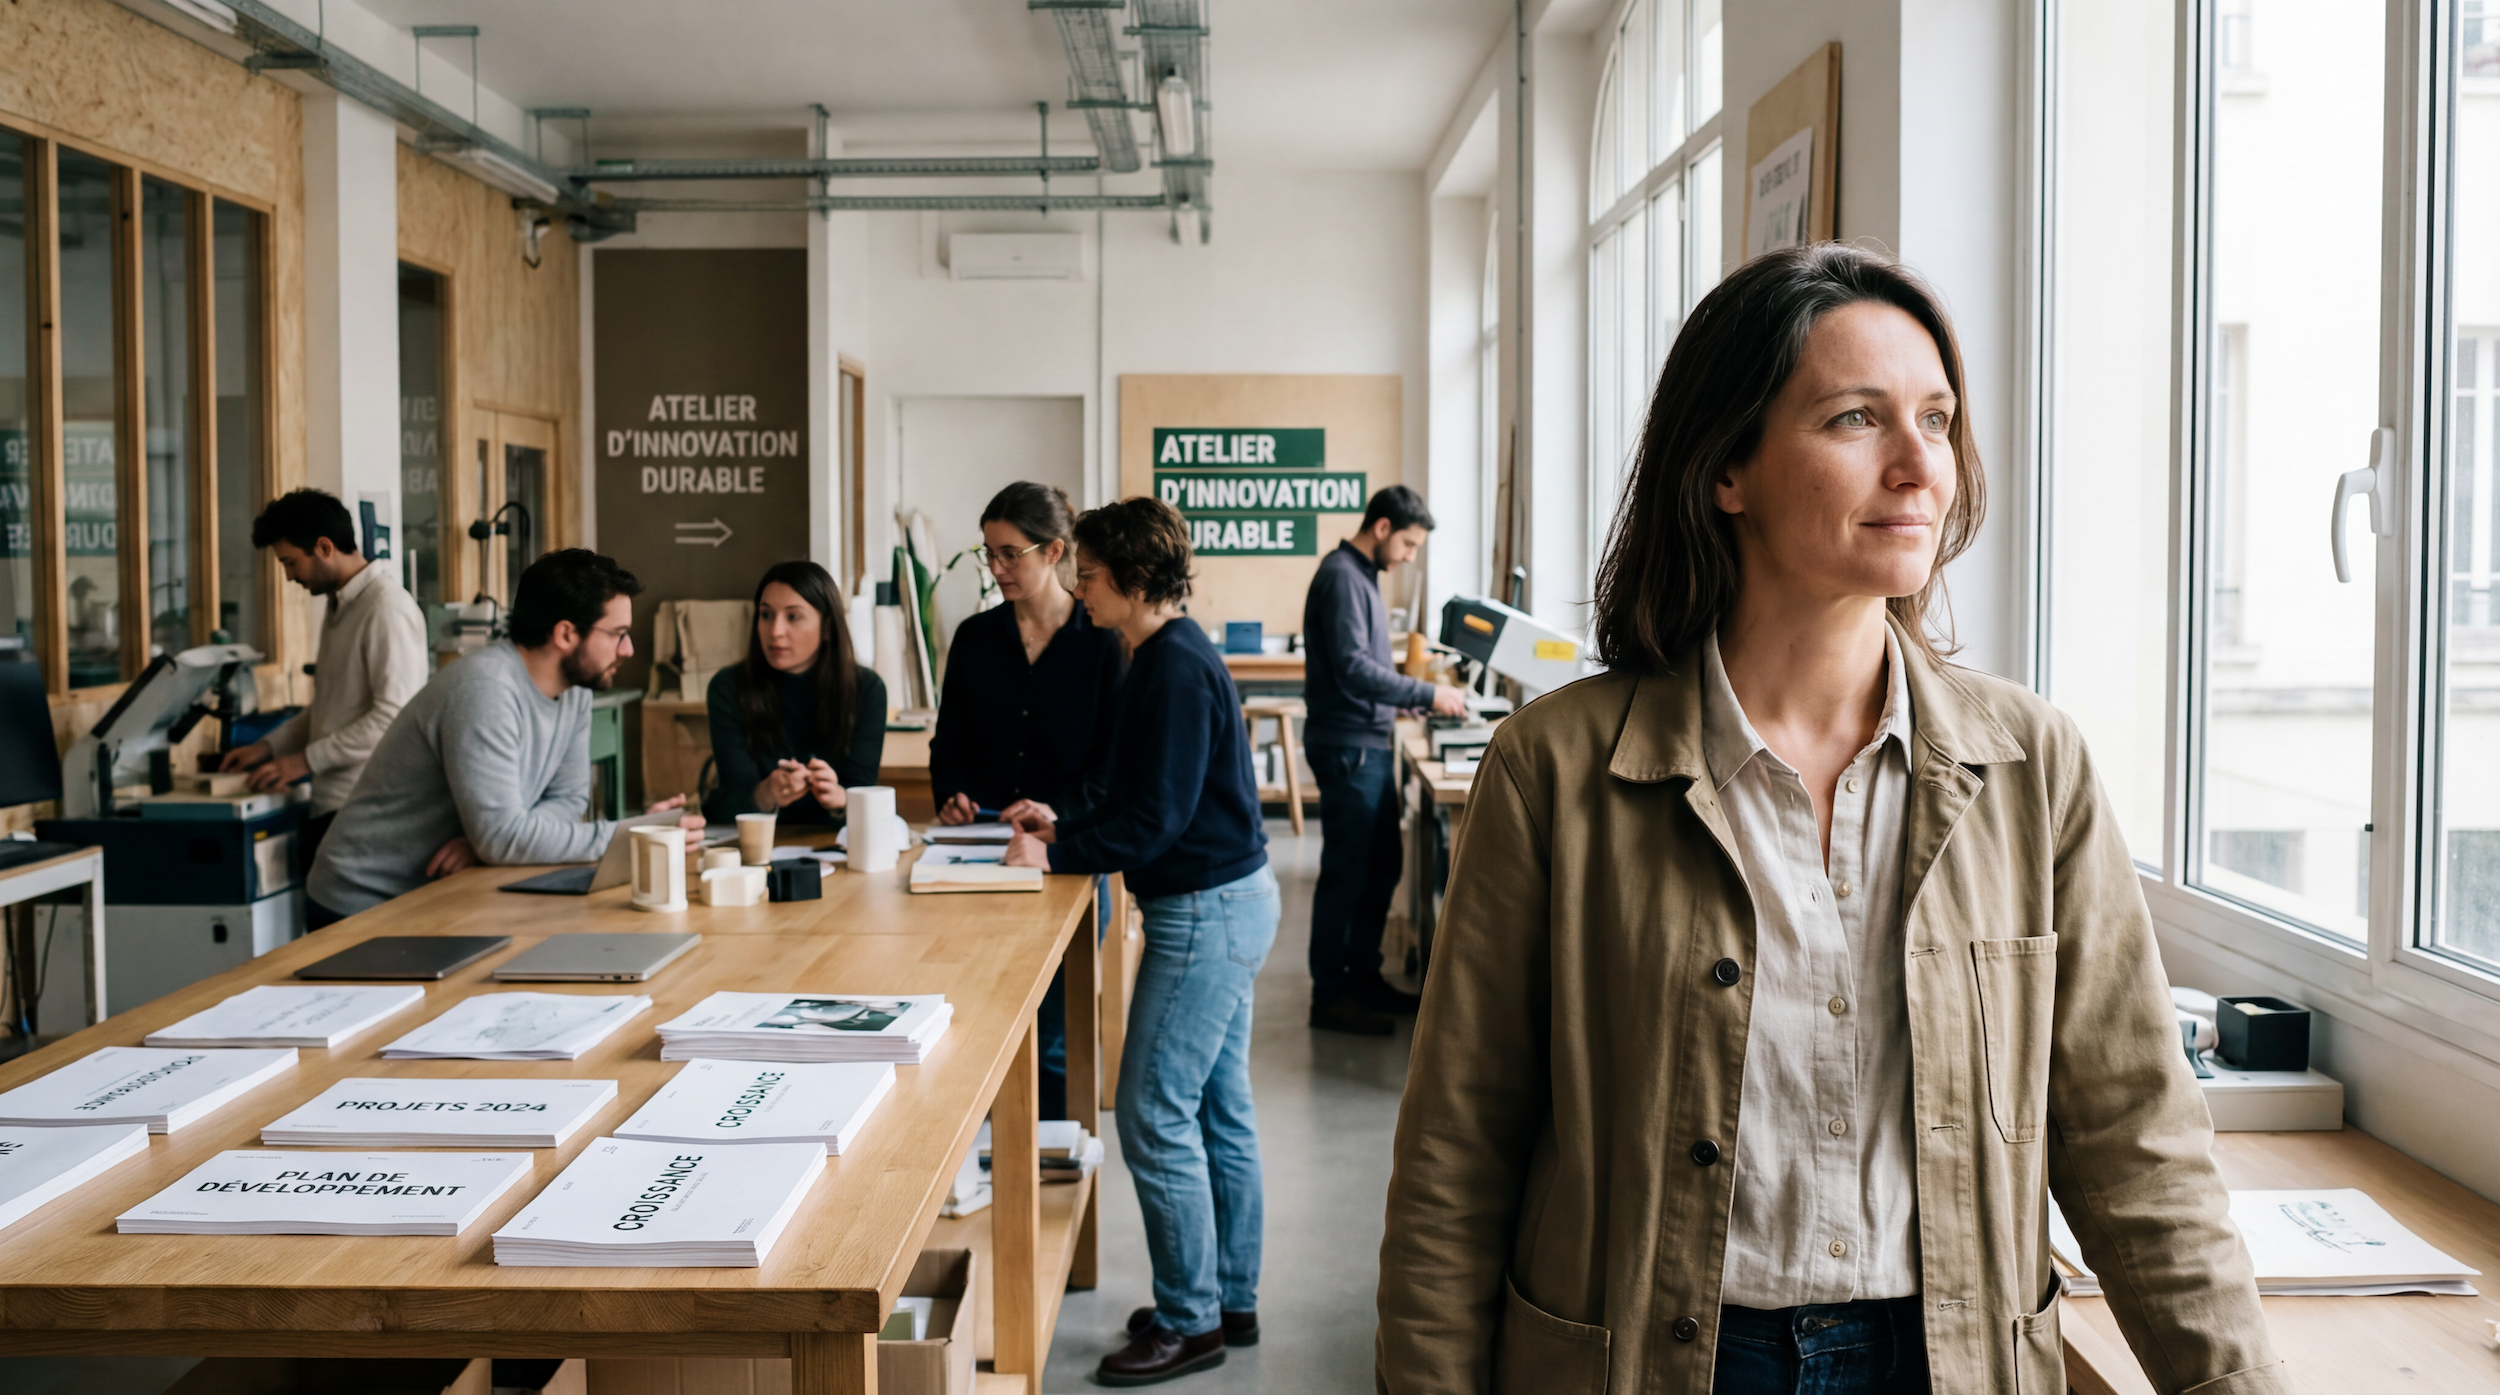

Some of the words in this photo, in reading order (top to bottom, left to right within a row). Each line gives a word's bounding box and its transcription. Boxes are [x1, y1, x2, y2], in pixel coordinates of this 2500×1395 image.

[648, 394, 756, 421] ATELIER
[1160, 434, 1276, 464] ATELIER
[642, 466, 765, 494] DURABLE
[1185, 520, 1295, 550] URABLE
[336, 1101, 468, 1112] PROJETS
[474, 1102, 548, 1112] 2024
[715, 1072, 785, 1128] CROISSANCE
[196, 1179, 466, 1196] DÉVELOPPEMENT
[275, 1171, 361, 1182] PLAN
[365, 1172, 409, 1183] DE
[613, 1155, 703, 1231] CROISSANCE
